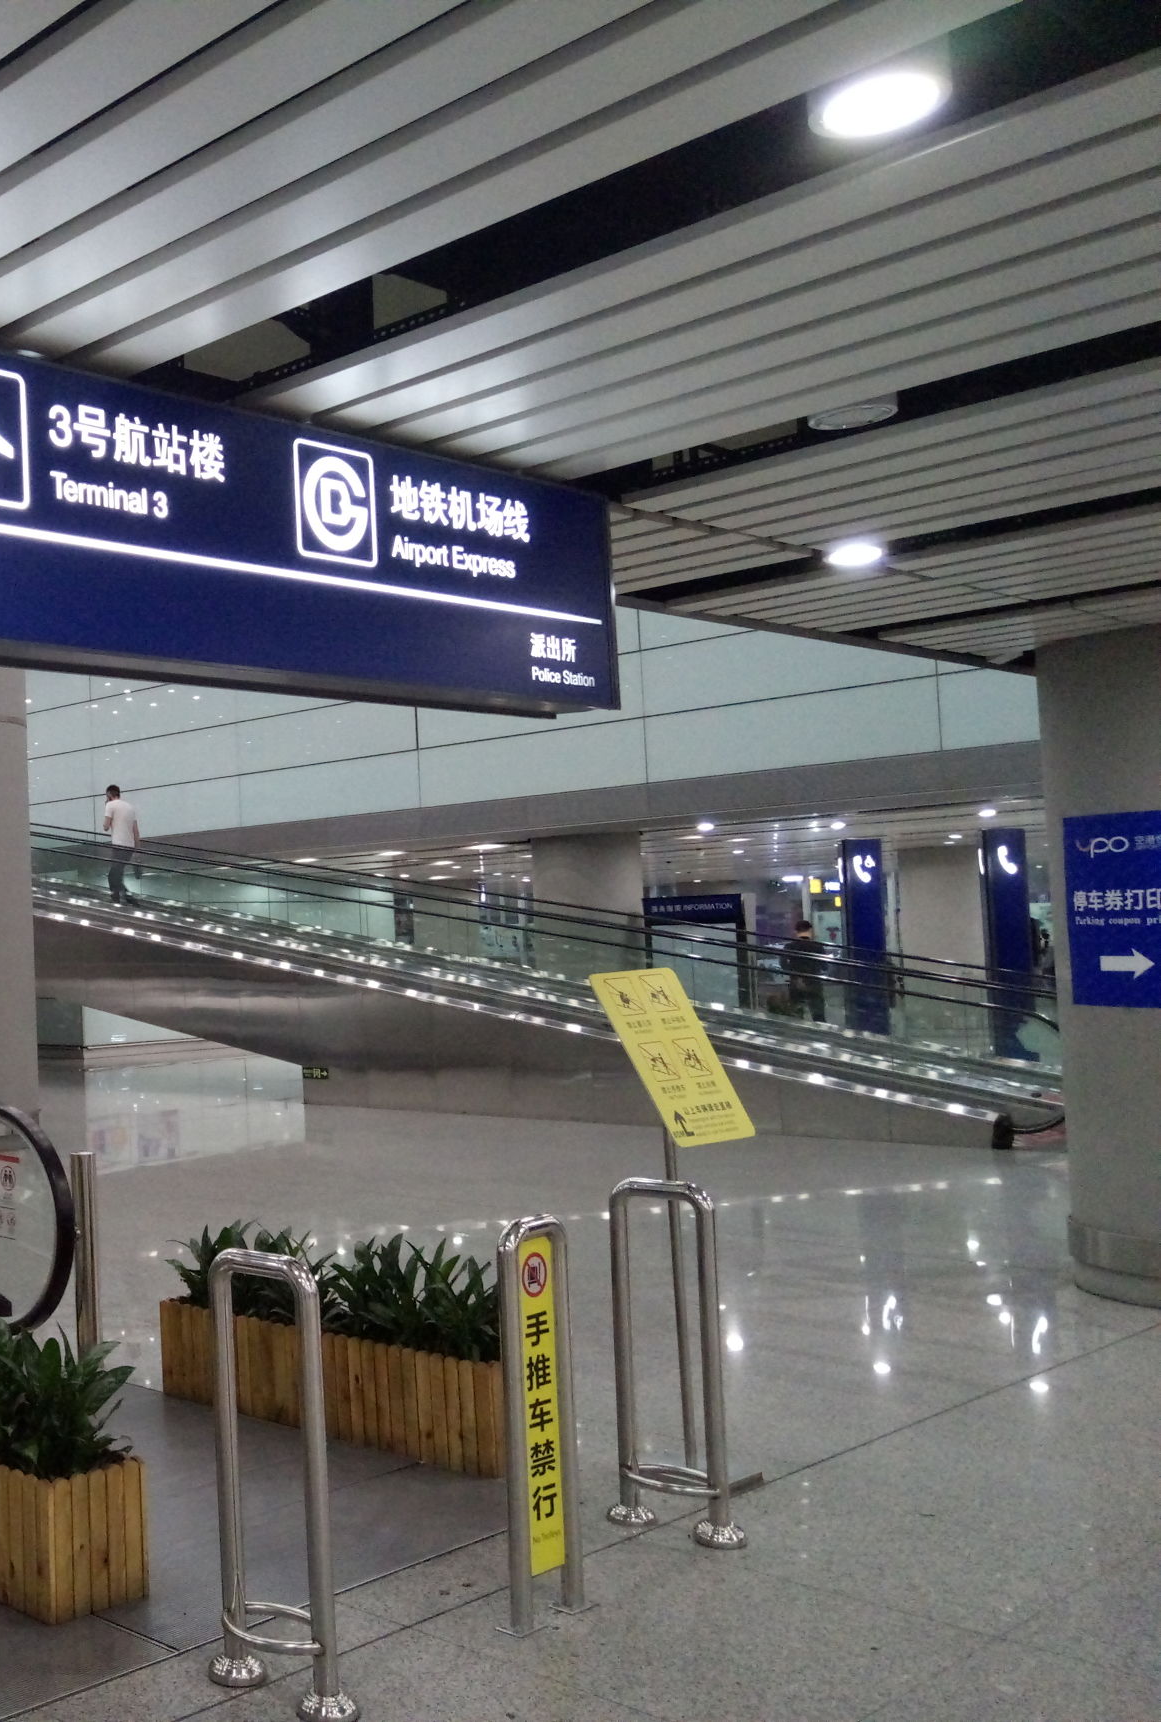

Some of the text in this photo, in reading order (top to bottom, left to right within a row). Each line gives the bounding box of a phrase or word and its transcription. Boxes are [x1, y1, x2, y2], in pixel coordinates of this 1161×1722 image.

[48, 405, 226, 483] 3号航站楼
[50, 471, 169, 518] Terminal 3
[389, 475, 531, 543] 地铁机场线
[391, 535, 517, 579] Airport Express
[530, 632, 577, 663] 派出所
[531, 665, 596, 688] Police Station
[525, 1309, 558, 1522] 手推车禁行
